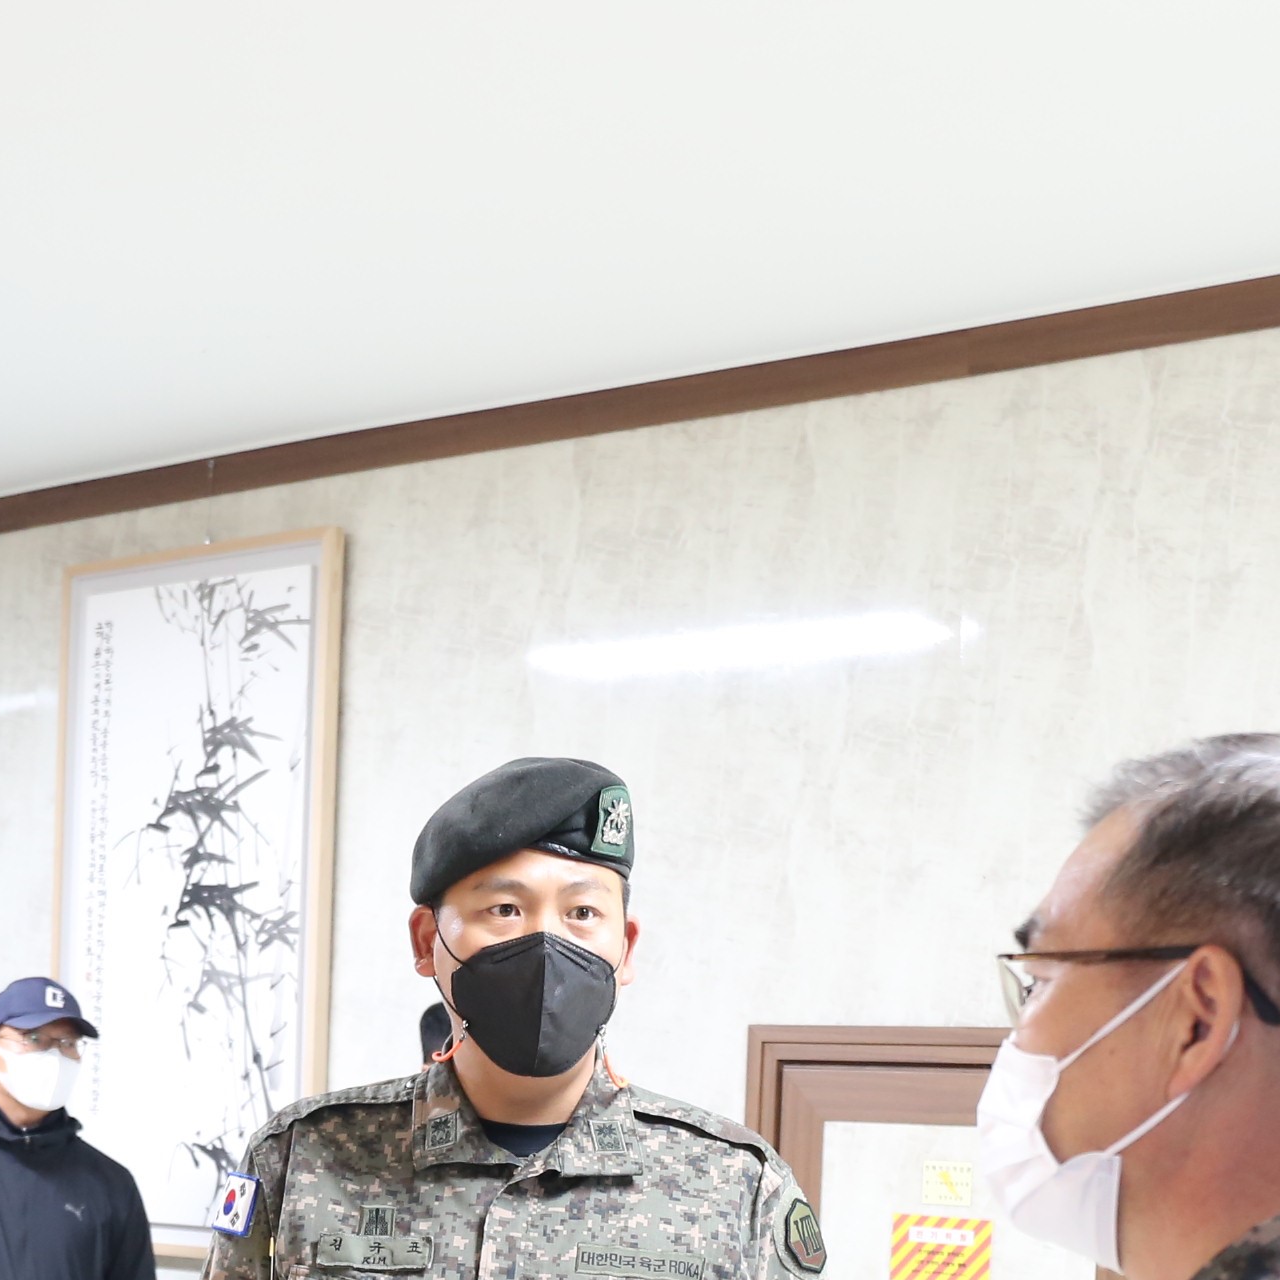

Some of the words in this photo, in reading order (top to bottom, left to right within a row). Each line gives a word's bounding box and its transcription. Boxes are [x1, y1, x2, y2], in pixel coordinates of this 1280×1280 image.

[362, 1256, 387, 1265] KIM
[580, 1251, 636, 1269] 대한민국
[638, 1257, 667, 1273] 육군
[669, 1259, 700, 1279] ROKA
